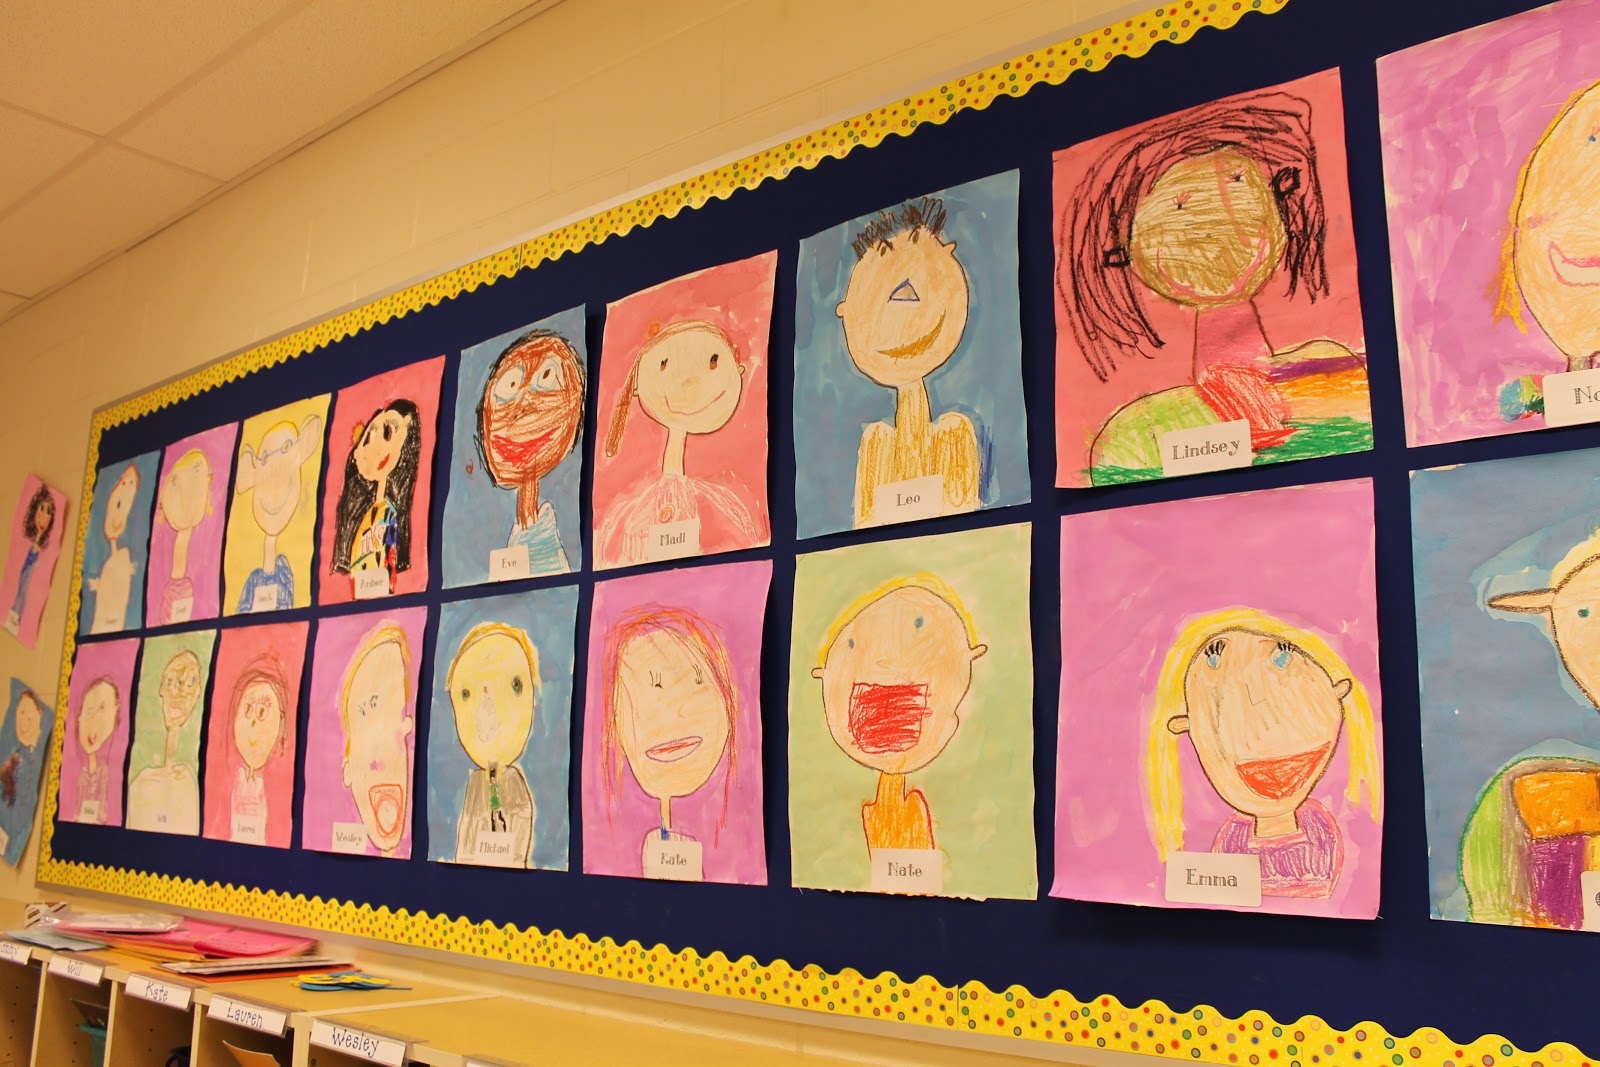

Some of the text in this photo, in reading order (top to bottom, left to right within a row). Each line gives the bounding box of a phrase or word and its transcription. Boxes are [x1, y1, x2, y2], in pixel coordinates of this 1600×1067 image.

[1172, 439, 1241, 460] Lindsey
[896, 492, 921, 507] Leo
[659, 532, 687, 547] Madi
[501, 557, 518, 569] Eve
[479, 841, 510, 854] Michael
[660, 852, 687, 866] Kate
[887, 862, 923, 878] Nate
[1185, 868, 1238, 887] Emma
[67, 960, 84, 976] Will
[145, 980, 169, 1002] Kate
[226, 1002, 263, 1028] Lauren
[332, 1027, 380, 1058] Wesley
